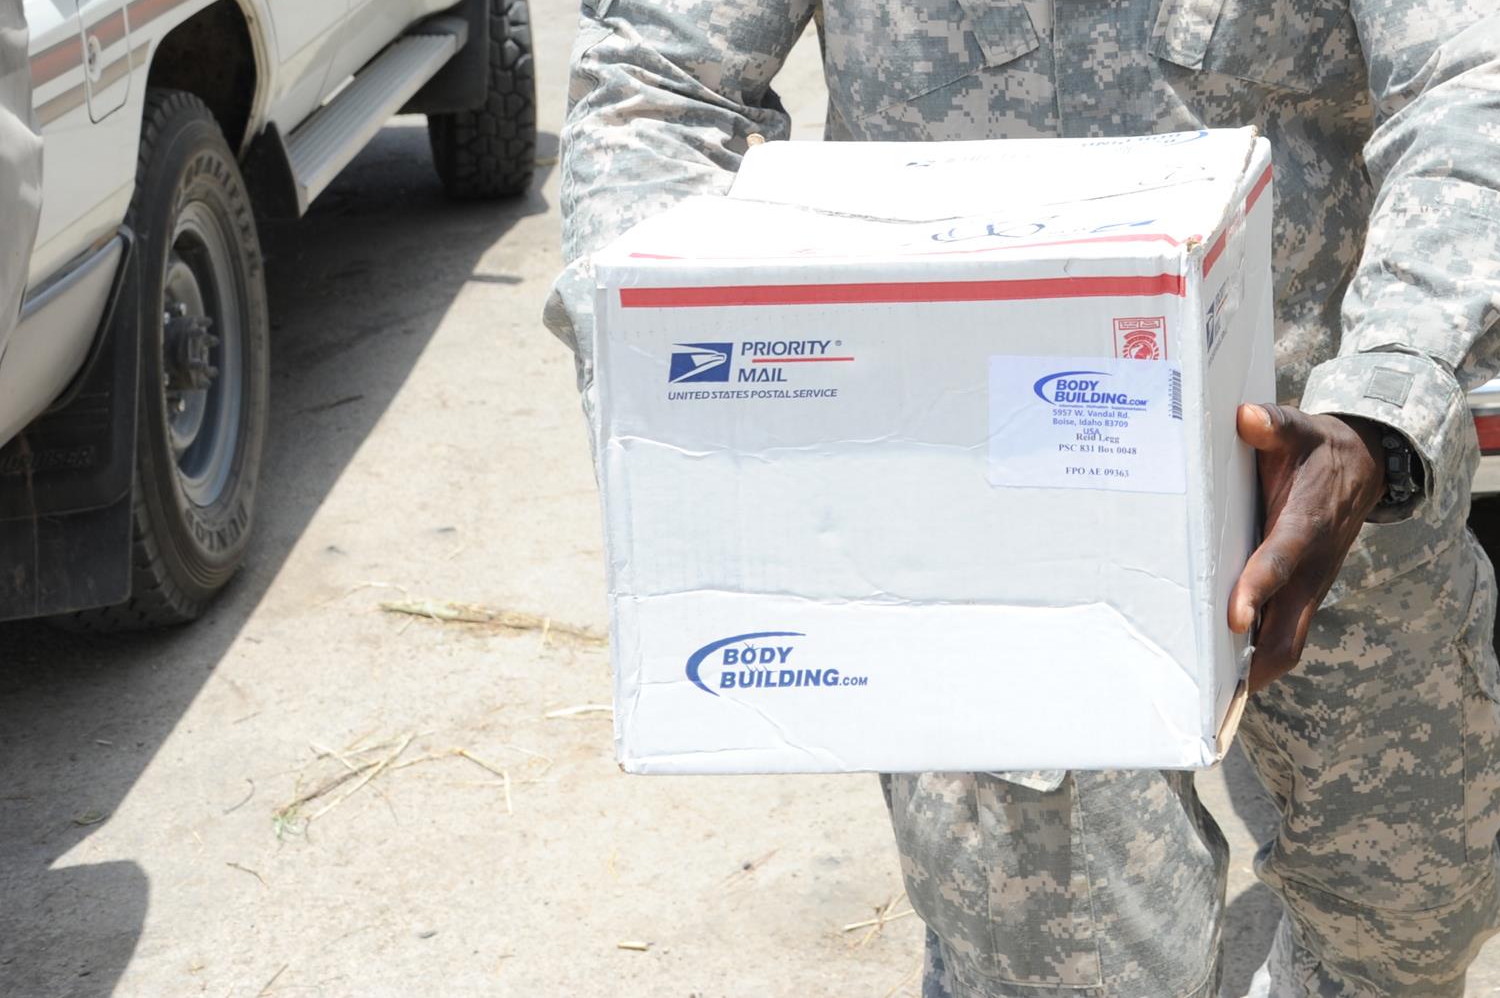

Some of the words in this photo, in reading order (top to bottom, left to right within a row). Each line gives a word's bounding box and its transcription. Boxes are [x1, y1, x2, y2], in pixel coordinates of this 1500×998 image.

[740, 340, 831, 356] PRIORITY
[738, 368, 788, 383] MAIL
[1056, 379, 1099, 391] BODY
[668, 390, 710, 401] UNITED
[711, 389, 749, 400] STATES
[750, 389, 791, 399] POSTAL
[792, 388, 838, 398] SERVICE
[1052, 408, 1072, 417] 5957
[1087, 409, 1115, 418] Vandal
[1052, 418, 1077, 427] Boise,
[1079, 418, 1102, 427] Idaho
[1083, 427, 1100, 435] USA
[1058, 443, 1077, 452] PSC
[1098, 445, 1114, 453] Box
[1065, 466, 1086, 475] FPO
[722, 647, 794, 666] BODY
[719, 669, 868, 689] BUILDING.COM
